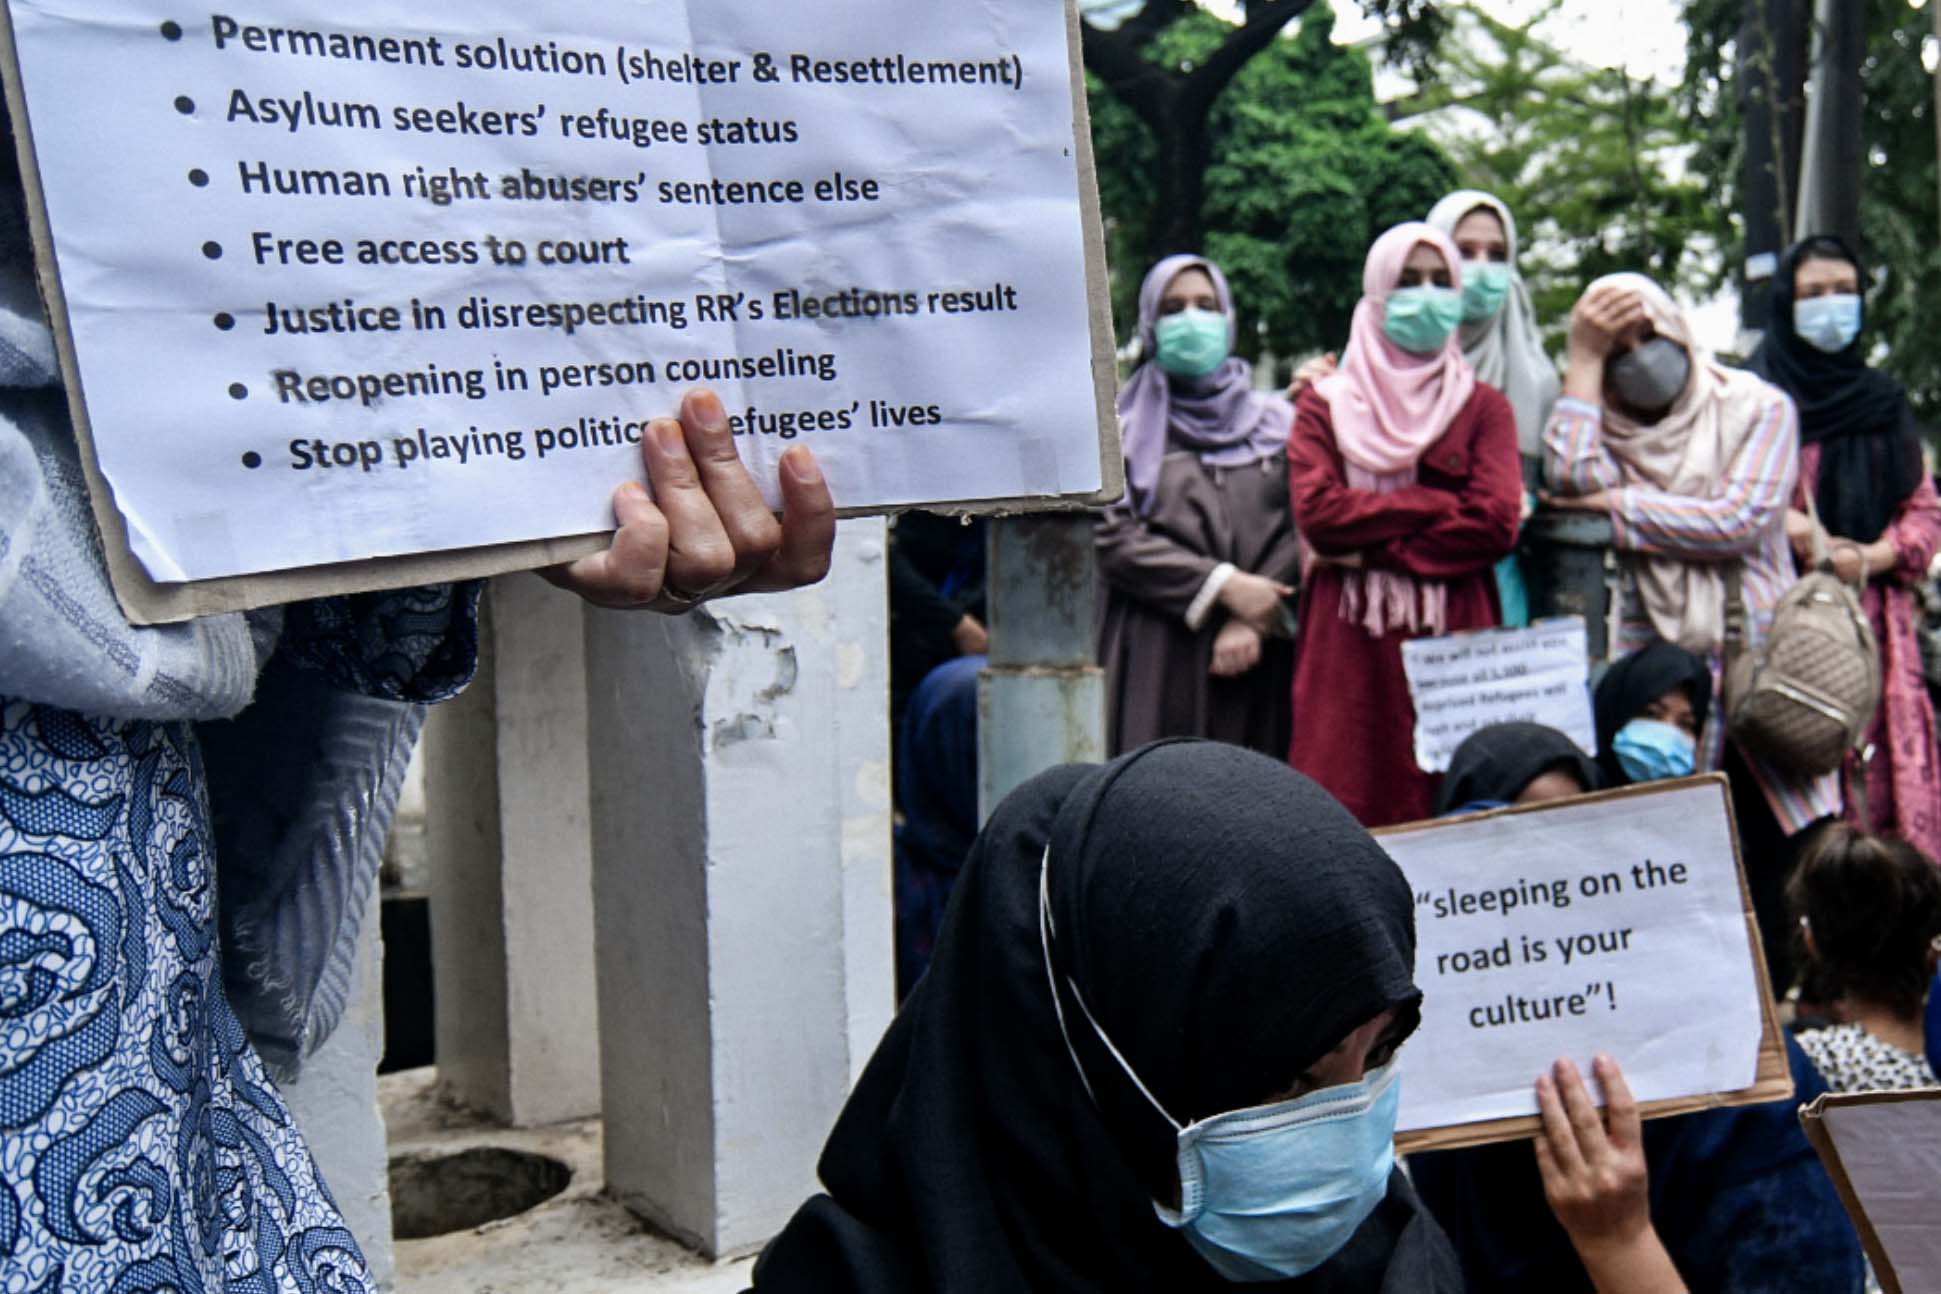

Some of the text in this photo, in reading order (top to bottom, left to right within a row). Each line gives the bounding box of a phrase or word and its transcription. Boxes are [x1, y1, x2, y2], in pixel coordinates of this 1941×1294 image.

[211, 14, 1023, 91] Permanent solution (shelter & Resettlement)
[226, 88, 799, 149] Asylum seekers’ refugee status
[238, 160, 879, 207] Human right abusers’ sentence else
[251, 231, 631, 267] Free access to court
[264, 282, 1018, 337] Justice in disrespecting RR’s Elections result
[272, 348, 837, 408] Reopening in person counseling
[289, 438, 383, 473] Stop
[391, 425, 526, 468] playing
[727, 401, 860, 438] efugees’
[869, 400, 942, 429] lives
[1417, 859, 1688, 919] “sleeping on the
[1436, 927, 1633, 975] road is your
